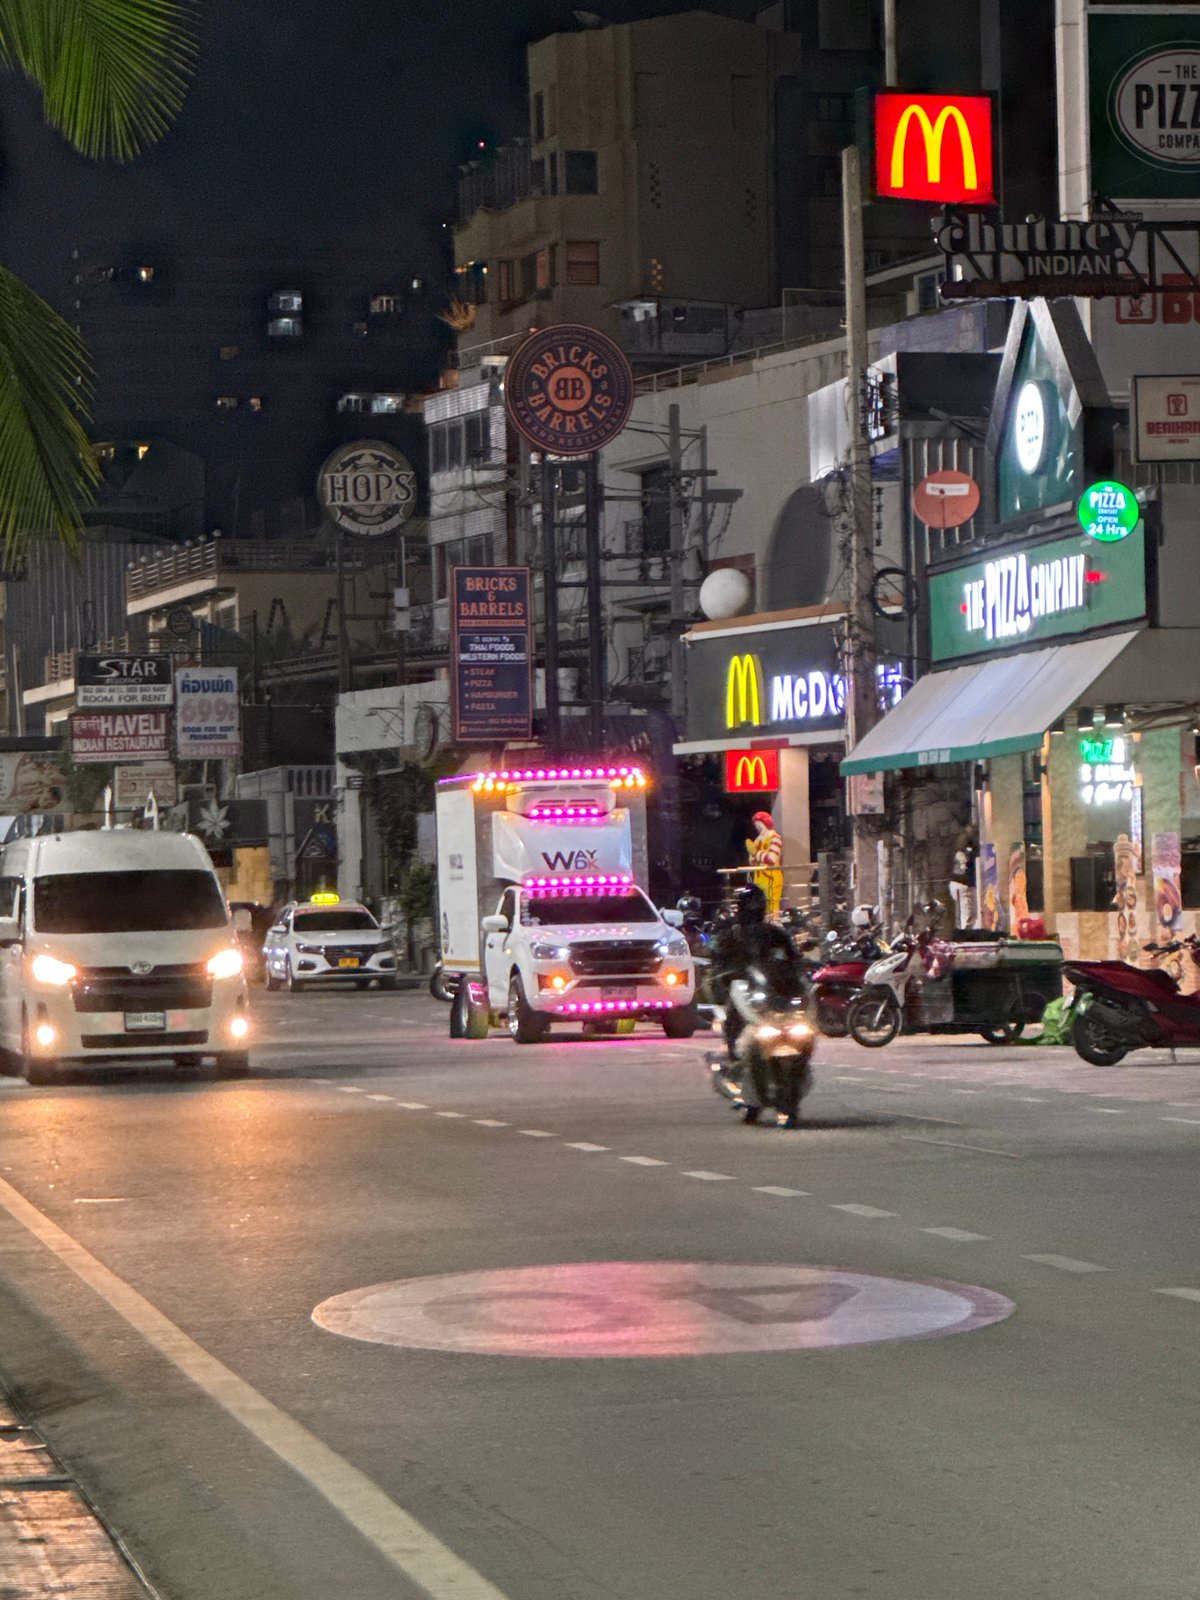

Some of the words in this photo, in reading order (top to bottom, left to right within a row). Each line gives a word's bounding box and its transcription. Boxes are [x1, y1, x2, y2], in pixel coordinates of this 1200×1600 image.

[1176, 65, 1198, 79] THE
[1028, 256, 1112, 275] INDIAN
[531, 346, 609, 381] BRICKS
[528, 392, 613, 433] BARRELS
[327, 473, 412, 503] HOPS
[1089, 491, 1126, 509] PIZZA
[1088, 523, 1104, 535] 24
[465, 577, 518, 591] BRICKS
[964, 579, 985, 632] THE
[984, 552, 1031, 641] PIZZA
[1030, 553, 1086, 618] COMPANY
[460, 602, 525, 616] BARRELS
[142, 694, 167, 702] RENT
[100, 713, 166, 736] HAVELI
[73, 738, 104, 752] INDIAN
[106, 736, 165, 750] RESTAURANT
